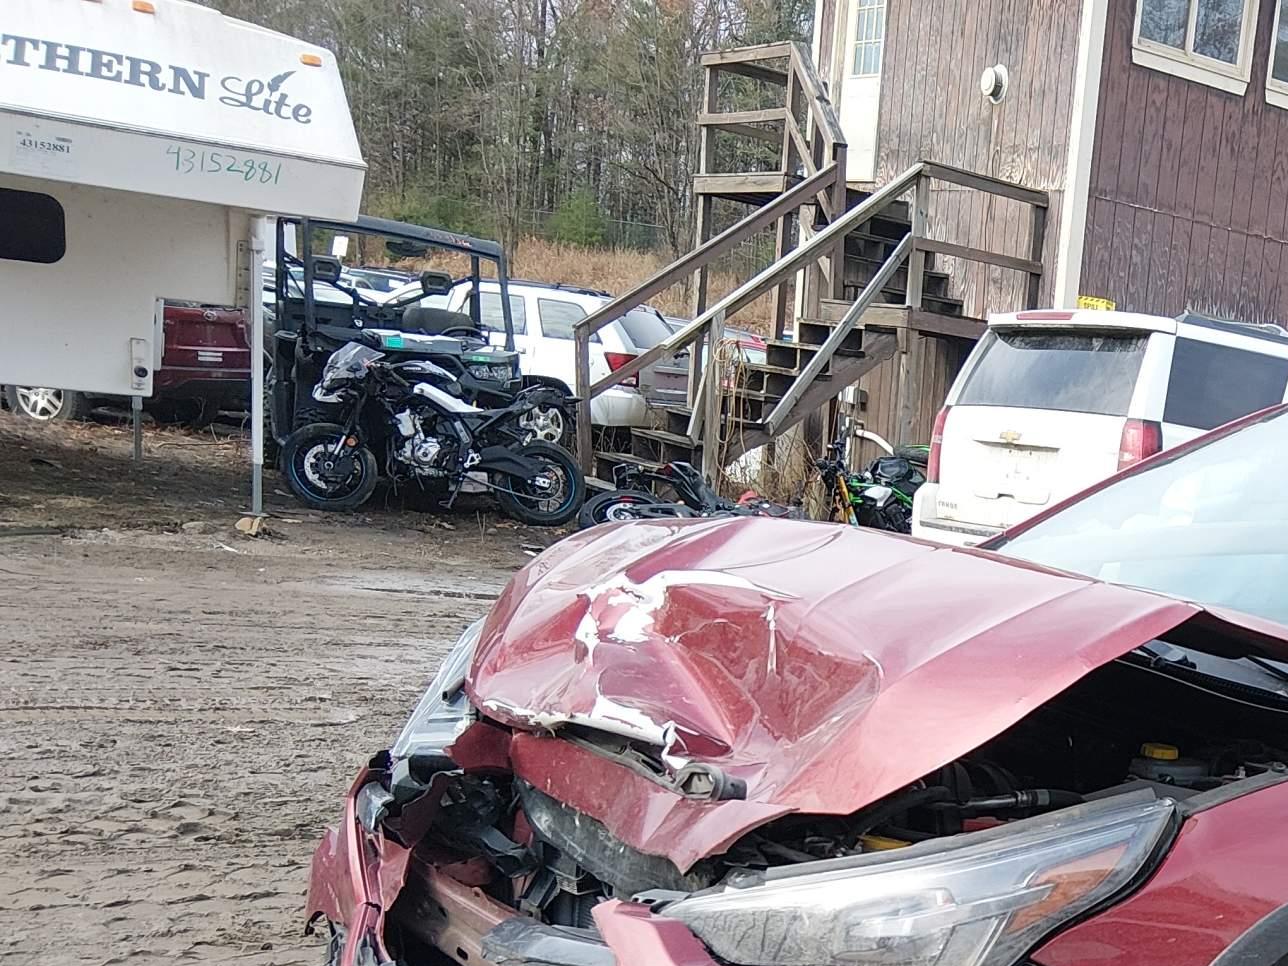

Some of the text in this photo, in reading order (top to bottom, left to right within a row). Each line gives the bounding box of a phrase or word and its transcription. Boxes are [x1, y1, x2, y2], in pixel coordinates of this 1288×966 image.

[218, 71, 313, 125] Lite
[20, 139, 71, 153] 43152881
[166, 145, 282, 185] 43152881
